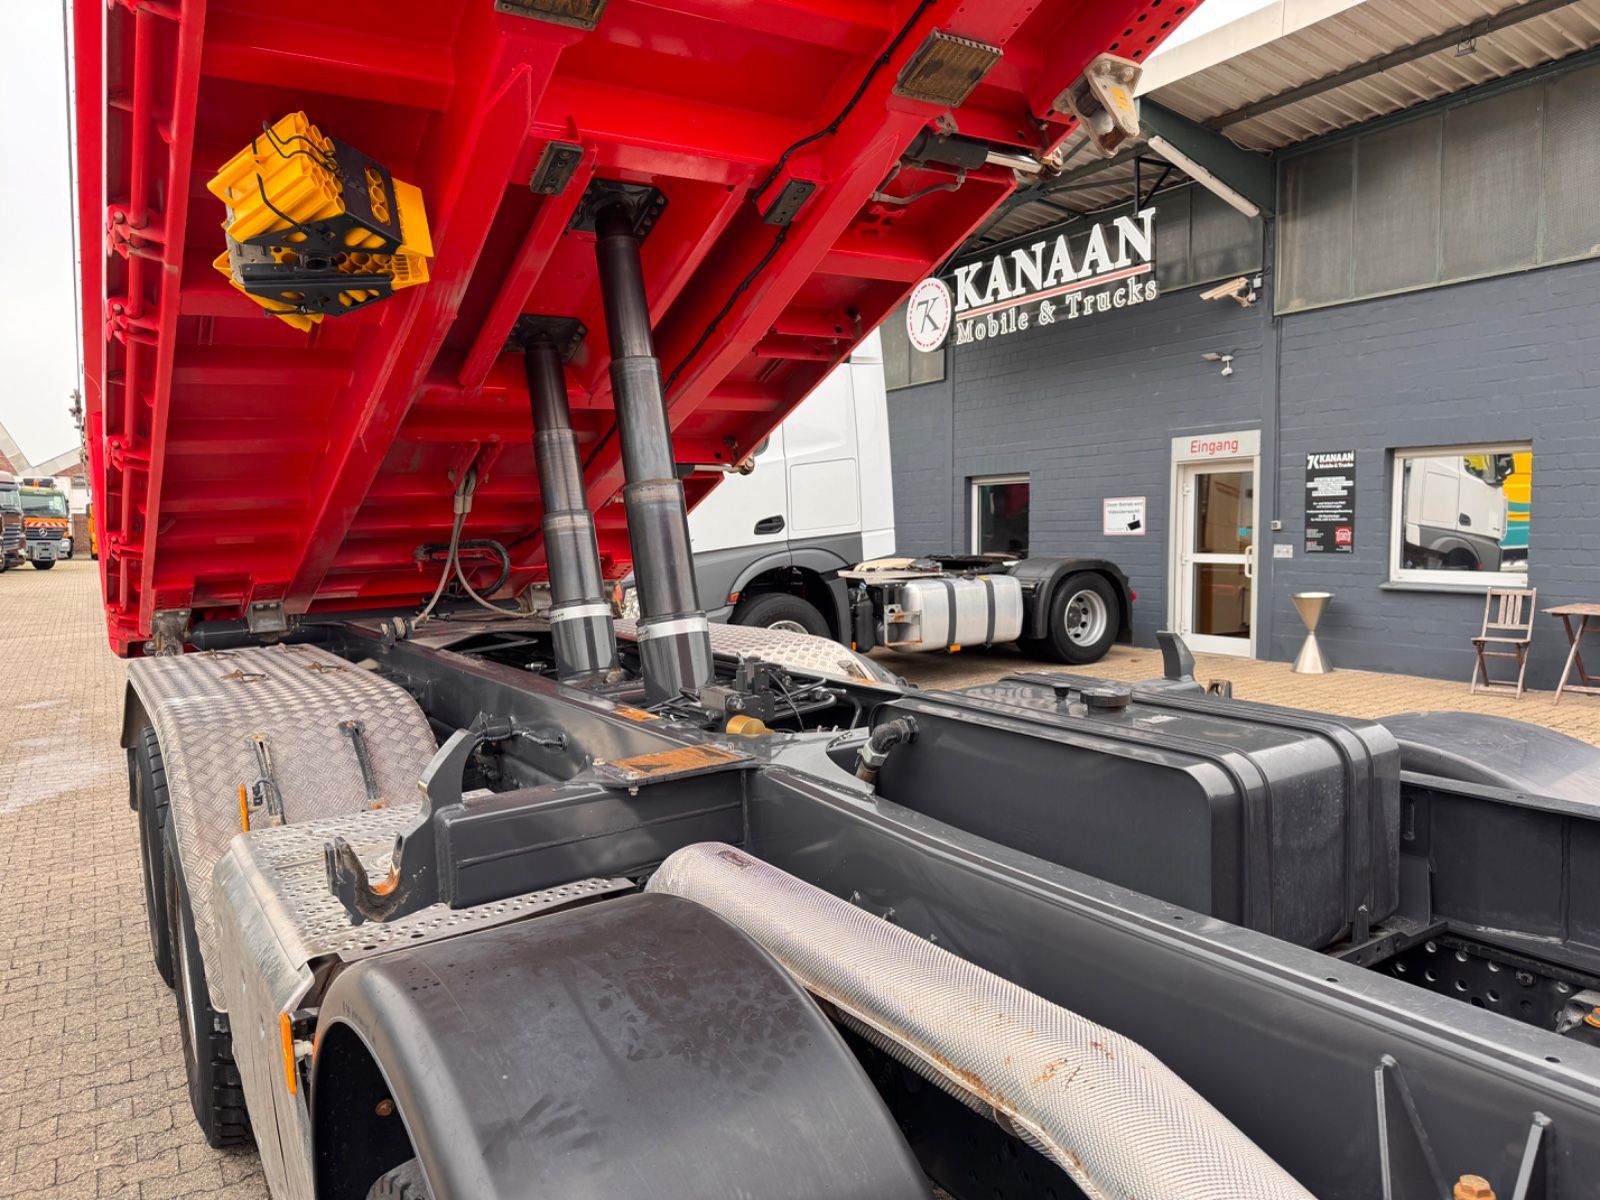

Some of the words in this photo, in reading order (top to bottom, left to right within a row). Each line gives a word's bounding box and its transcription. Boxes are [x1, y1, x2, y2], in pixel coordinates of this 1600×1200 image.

[954, 207, 1156, 312] KANAAN
[956, 307, 1028, 345] Mobile
[1038, 300, 1055, 326] &
[1066, 277, 1157, 320] Trucks
[1190, 440, 1238, 455] Eingang
[1319, 452, 1354, 463] KANAAN
